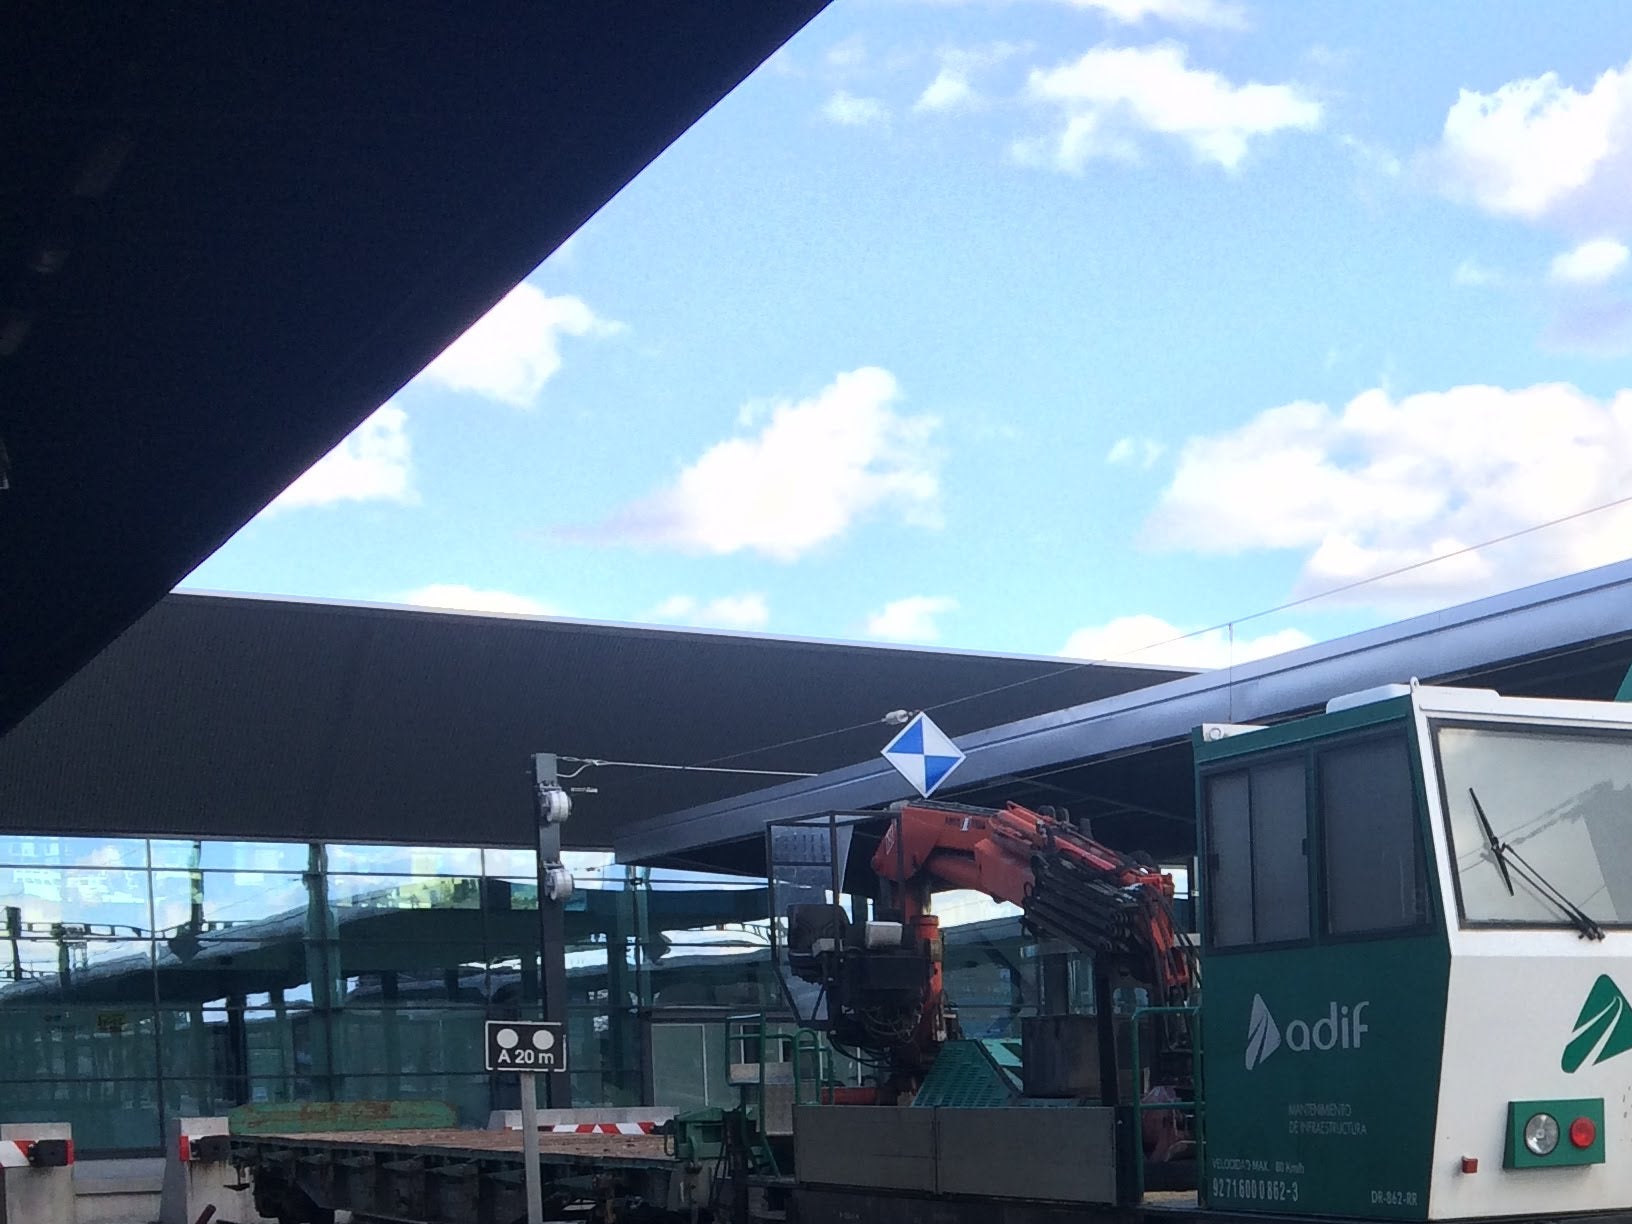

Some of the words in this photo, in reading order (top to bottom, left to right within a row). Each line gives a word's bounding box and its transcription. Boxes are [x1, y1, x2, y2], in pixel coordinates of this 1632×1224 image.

[1285, 1000, 1370, 1052] adif
[497, 1049, 512, 1064] A
[514, 1049, 535, 1064] 20
[538, 1052, 554, 1064] m
[1288, 1103, 1352, 1117] MANTENIMIENTO
[1288, 1120, 1299, 1135] DE
[1300, 1120, 1369, 1136] INFRAESTRUCTURA
[1371, 1190, 1418, 1206] DR-862-RR
